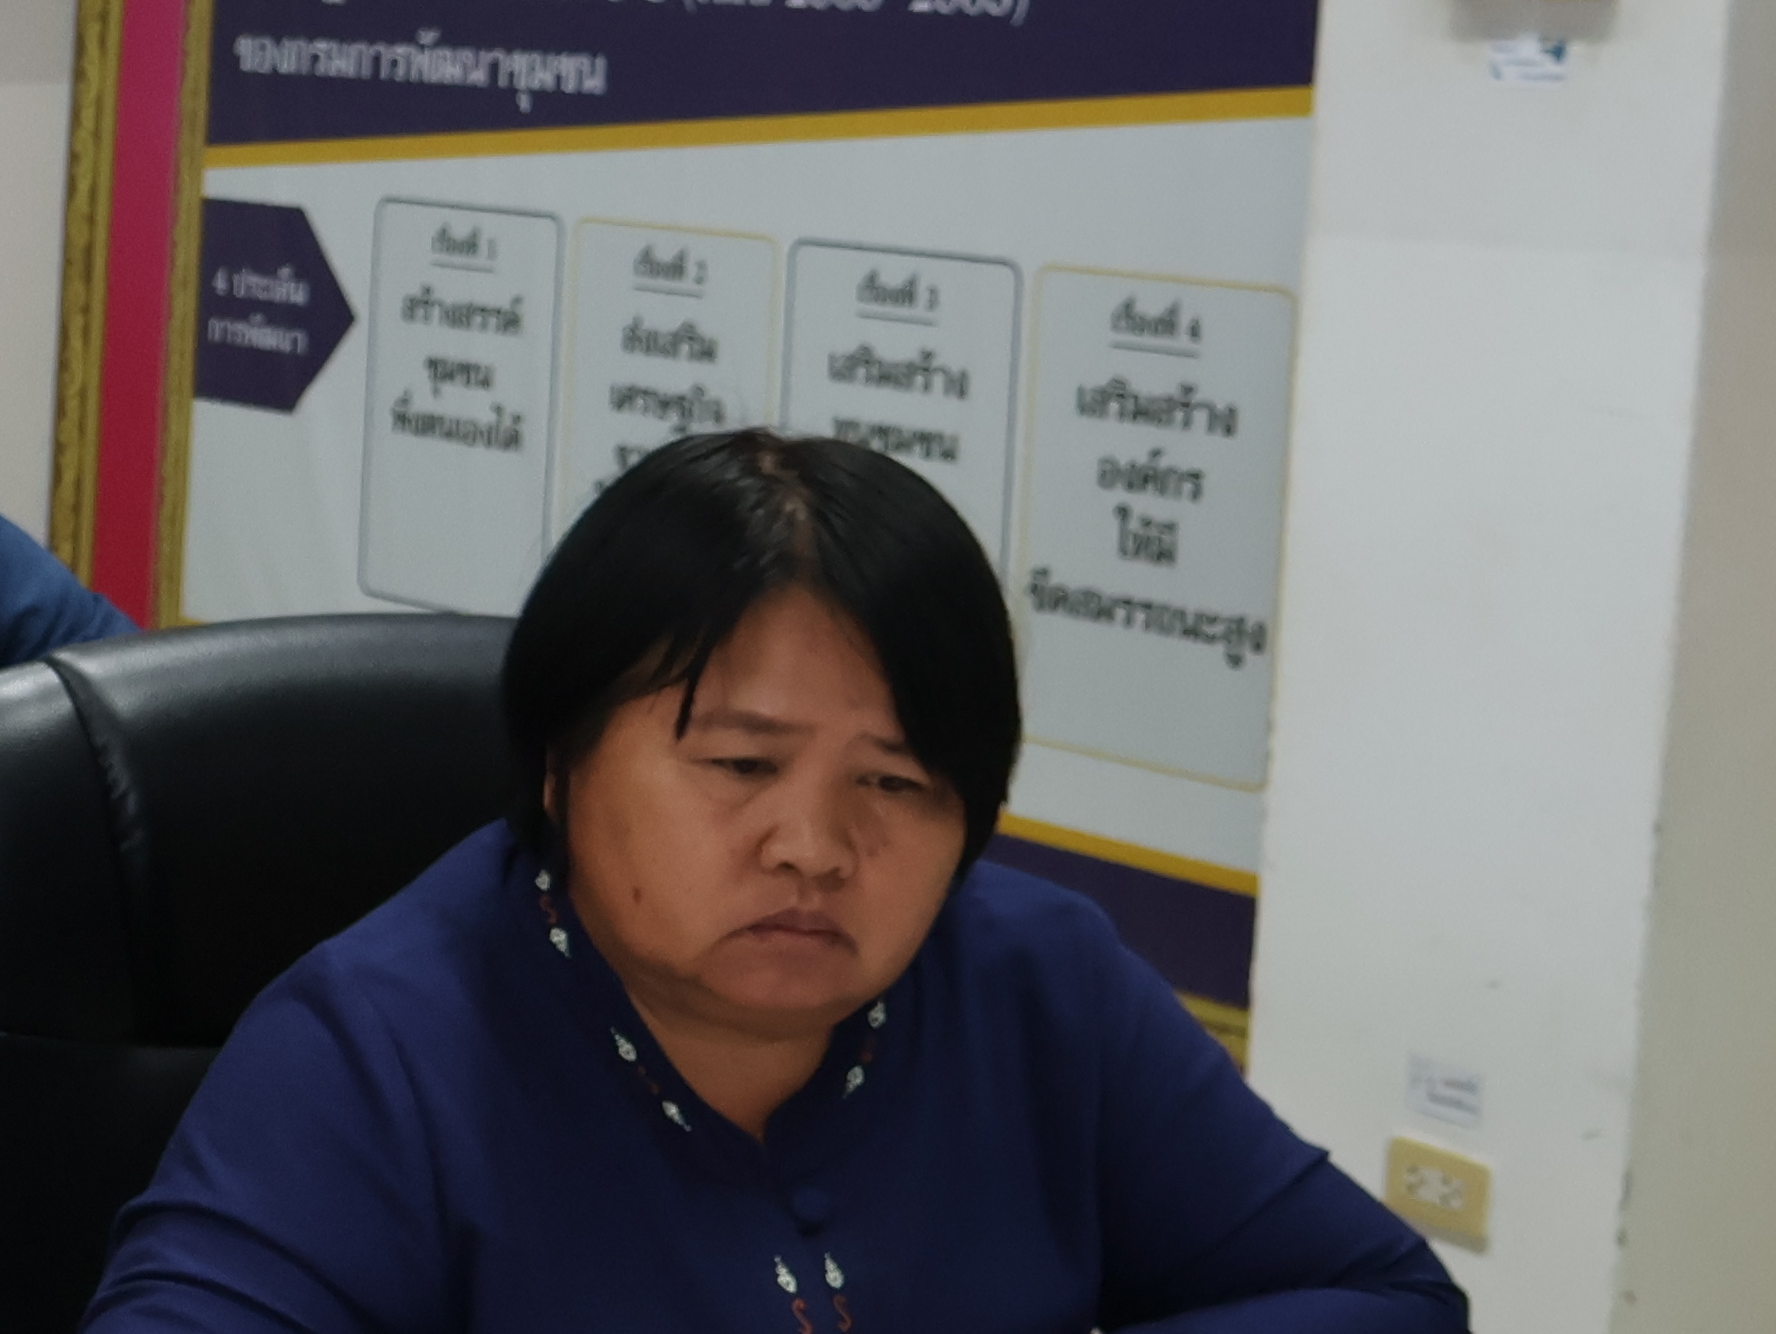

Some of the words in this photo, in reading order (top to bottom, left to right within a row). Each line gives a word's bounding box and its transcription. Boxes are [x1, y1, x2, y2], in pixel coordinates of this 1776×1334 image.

[233, 26, 608, 114] ของกรมการพัฒนาชุมชน
[206, 311, 311, 356] การพัฒนา
[1096, 449, 1206, 503] องค์กร
